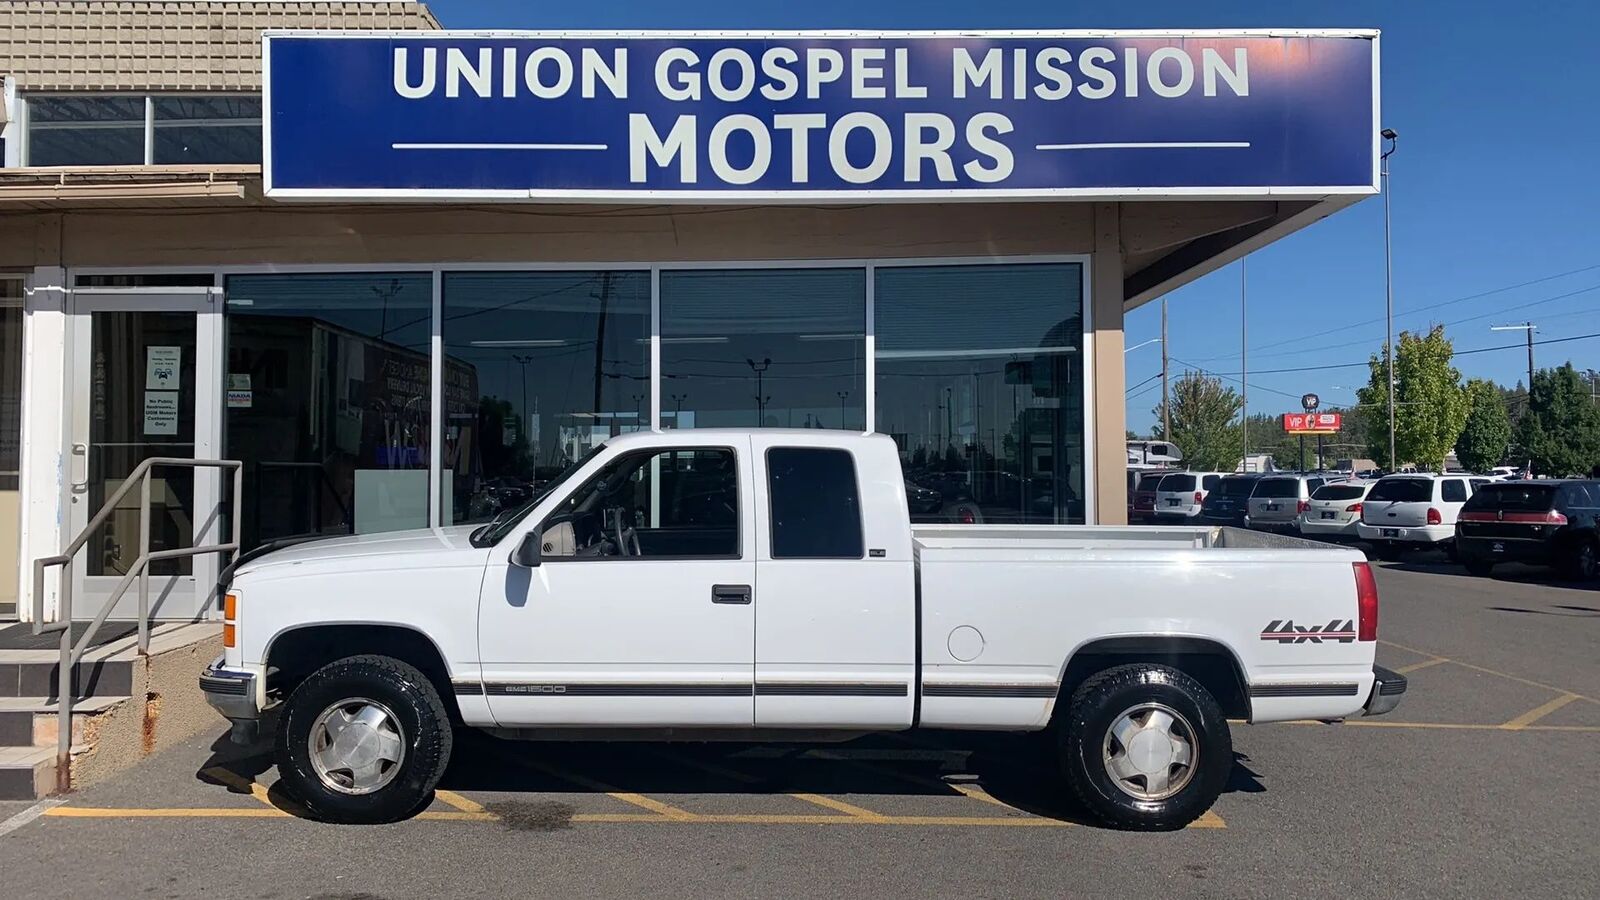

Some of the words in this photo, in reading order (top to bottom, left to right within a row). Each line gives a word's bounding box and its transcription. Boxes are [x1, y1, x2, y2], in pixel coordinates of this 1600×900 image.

[393, 46, 628, 100] UNION
[654, 46, 928, 102] GOSPEL
[952, 46, 1250, 101] MISSION
[629, 111, 1015, 186] MOTORS
[1306, 396, 1316, 406] VIP
[1289, 417, 1303, 427] VIP
[1260, 619, 1356, 643] 4x4
